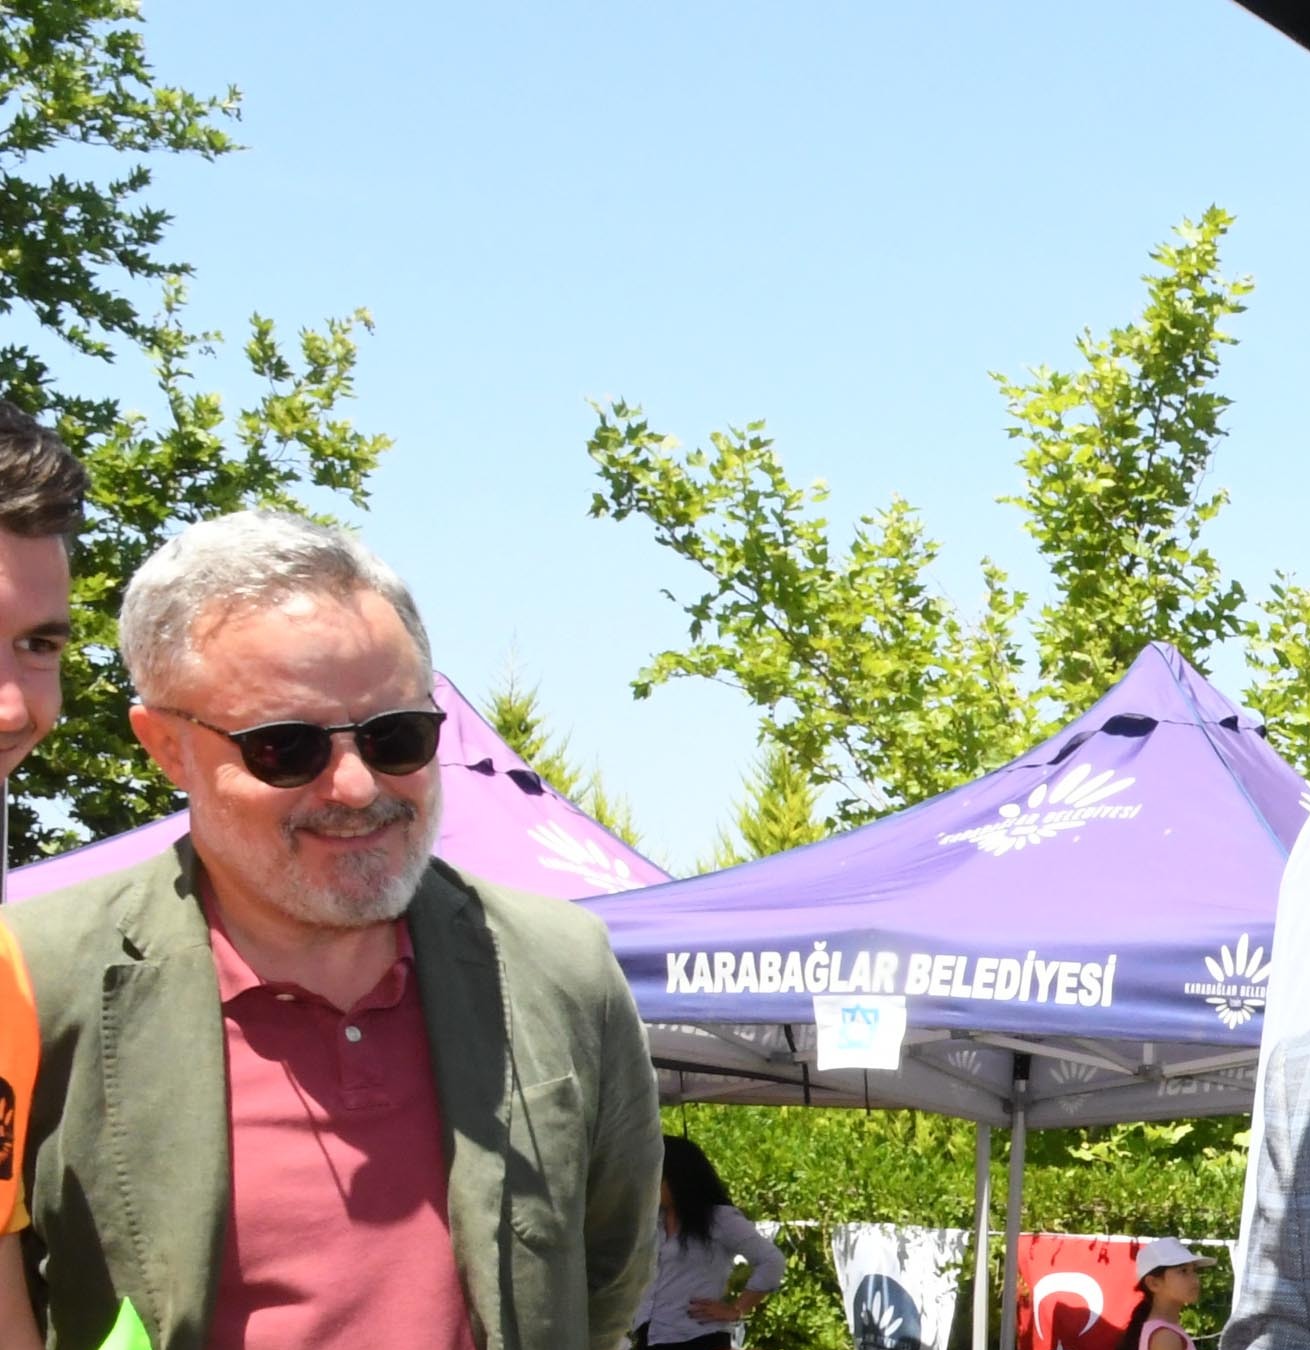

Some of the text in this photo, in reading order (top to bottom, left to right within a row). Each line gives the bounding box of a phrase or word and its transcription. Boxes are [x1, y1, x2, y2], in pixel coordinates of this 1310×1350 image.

[665, 940, 1118, 1008] KARABAĞLAR BELEDİYESİ
[1240, 984, 1266, 998] BELED
